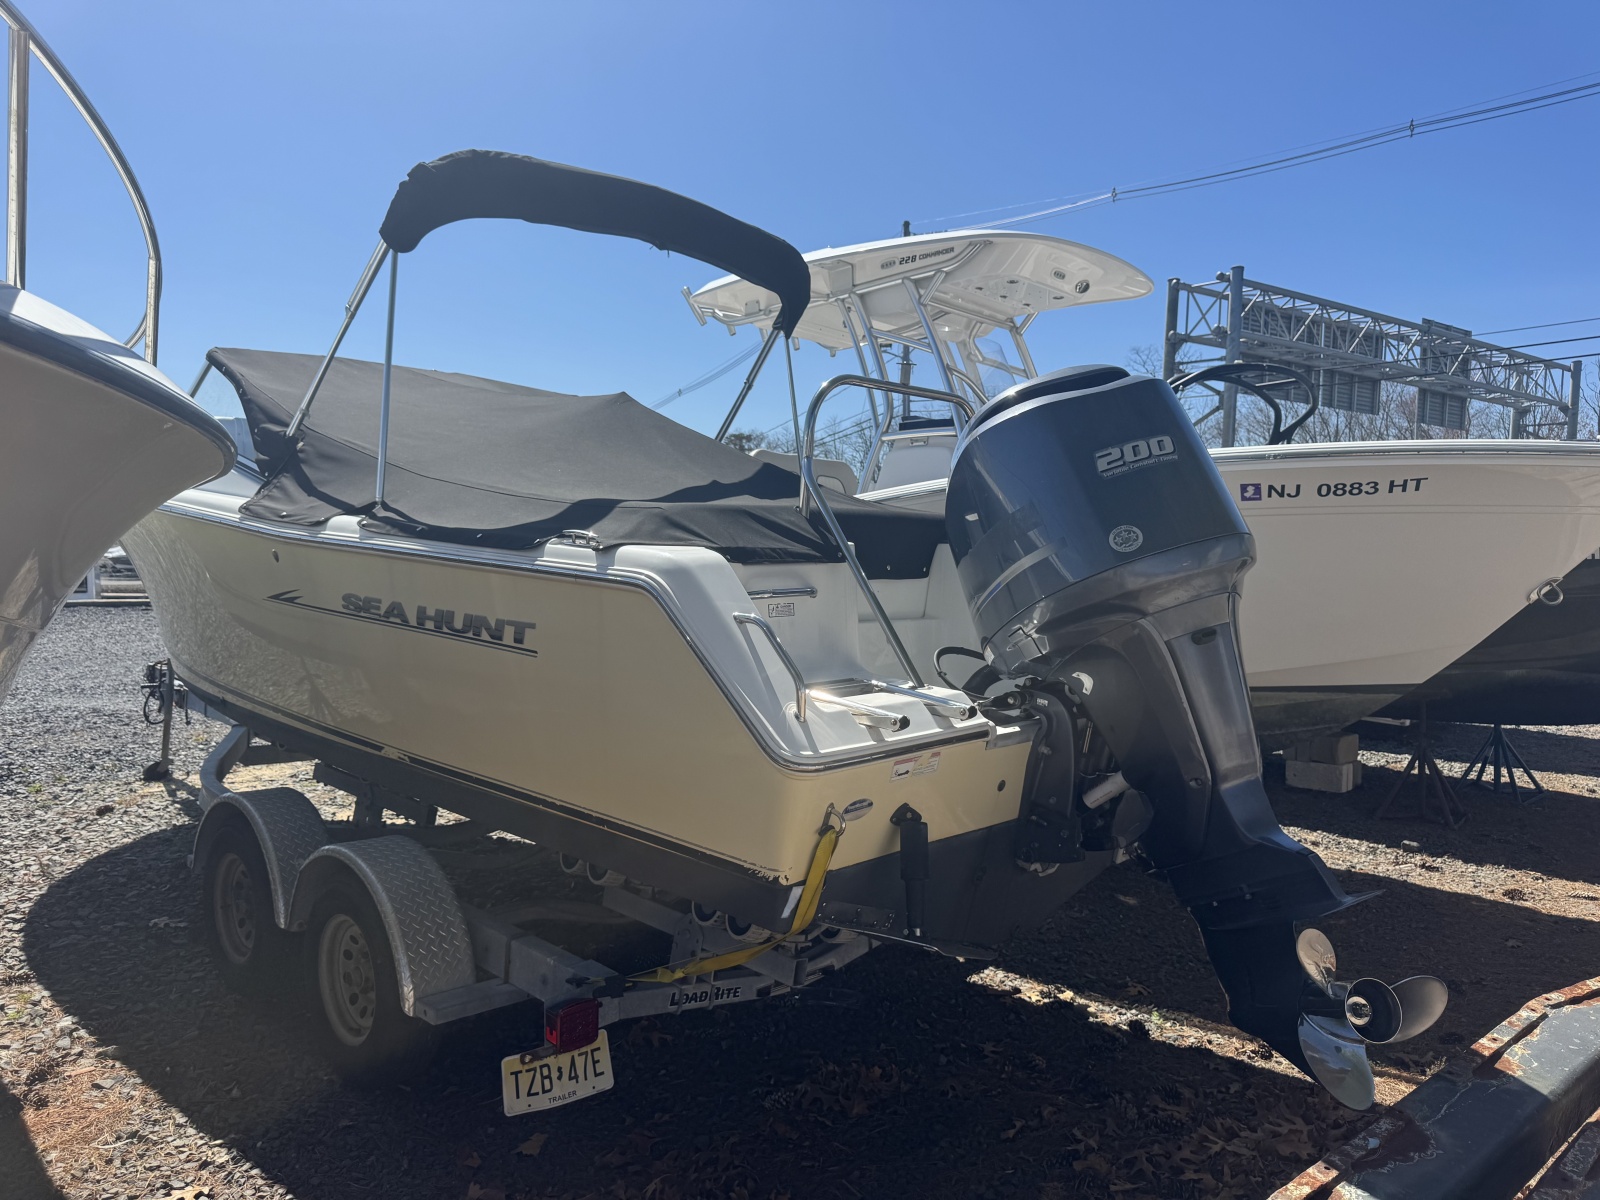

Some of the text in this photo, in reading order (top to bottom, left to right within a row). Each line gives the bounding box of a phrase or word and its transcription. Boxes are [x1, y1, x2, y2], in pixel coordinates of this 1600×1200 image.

[899, 247, 954, 265] 228 COMMANDER
[1096, 435, 1175, 472] 200
[1267, 477, 1428, 498] NJ 0883 HT
[341, 593, 536, 644] SEA HUNT
[548, 1090, 577, 1104] TRAILER
